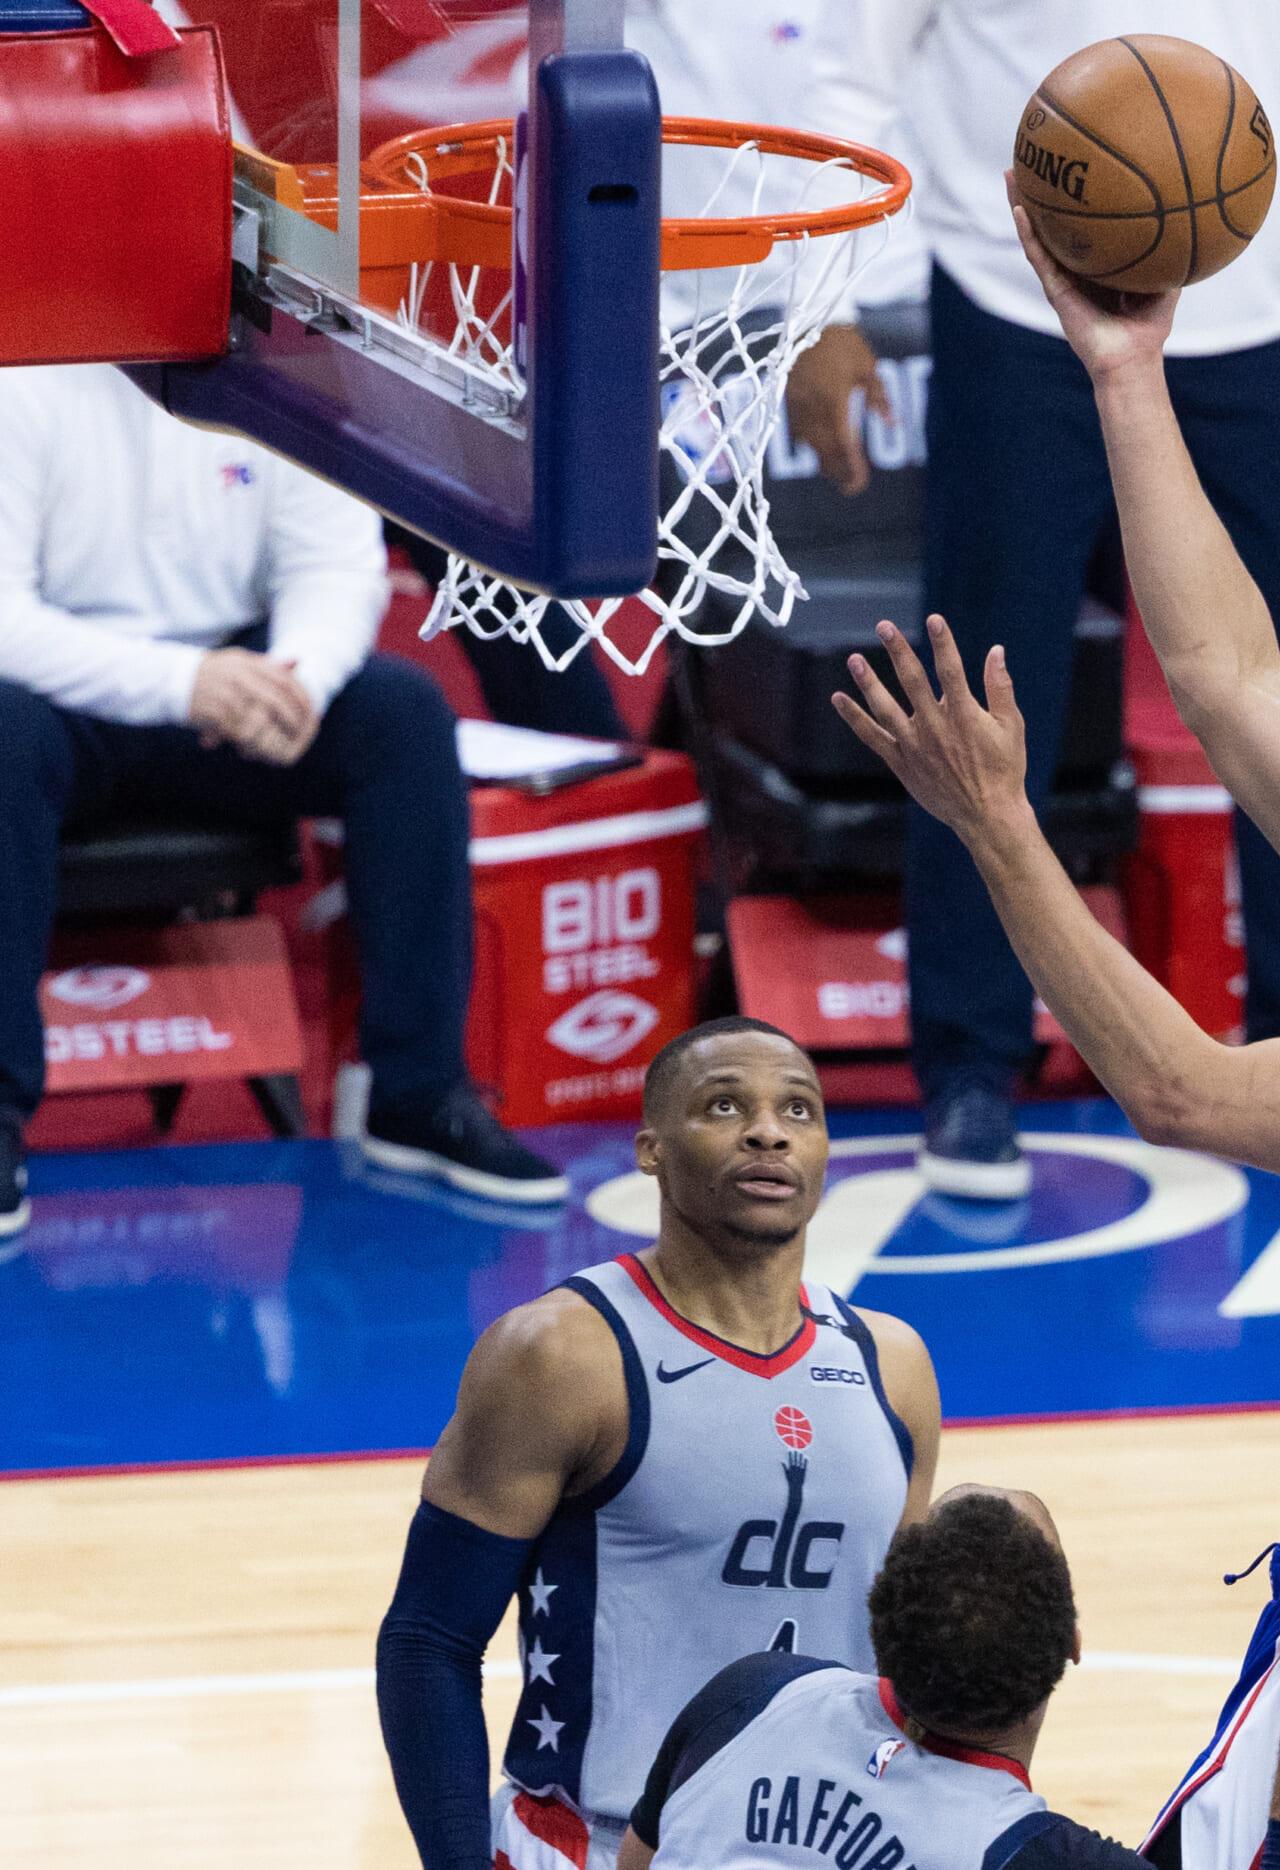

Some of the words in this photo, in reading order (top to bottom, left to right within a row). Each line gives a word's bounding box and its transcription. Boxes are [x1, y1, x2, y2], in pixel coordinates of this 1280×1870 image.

[543, 868, 660, 954] BIO
[544, 944, 660, 994] STEEL
[810, 1366, 866, 1386] GEICO
[721, 1458, 845, 1589] dc
[745, 1775, 917, 1870] GAFFOR
